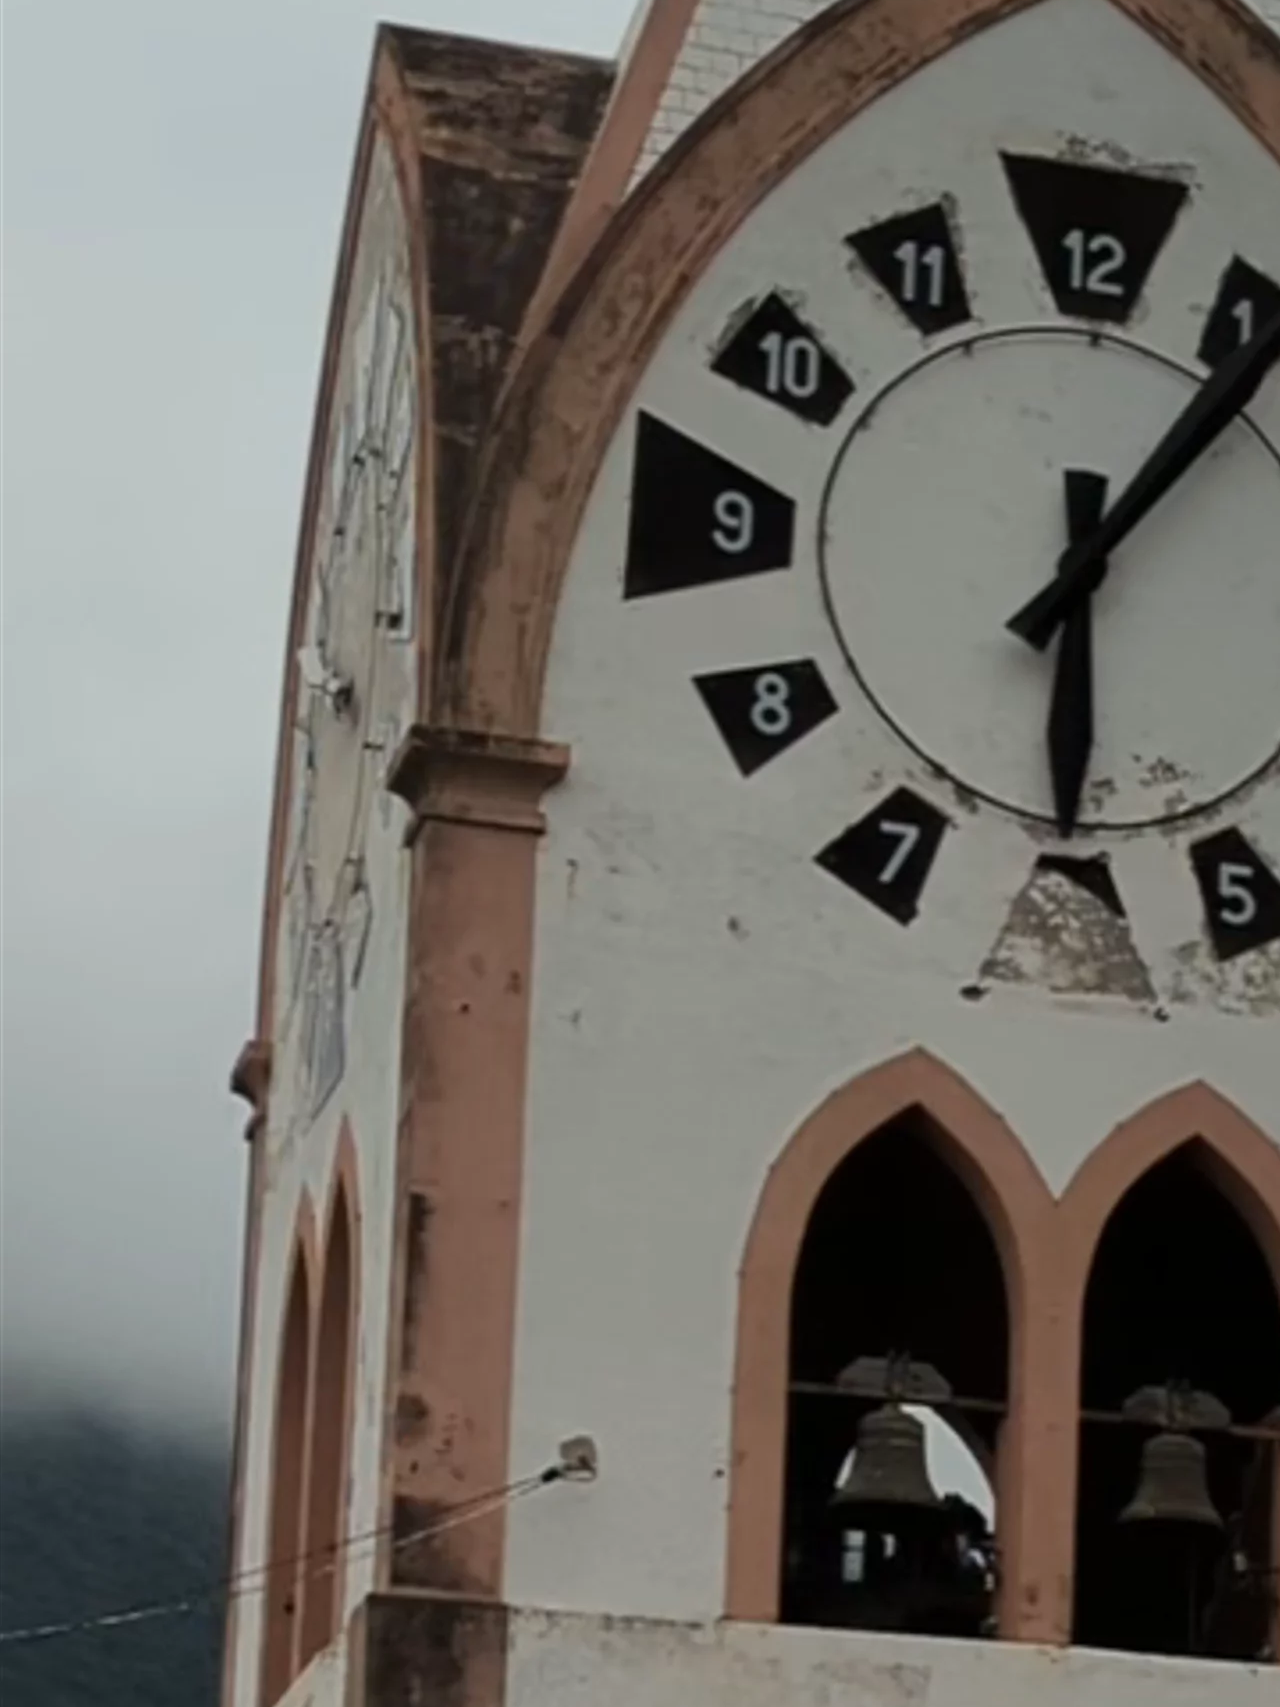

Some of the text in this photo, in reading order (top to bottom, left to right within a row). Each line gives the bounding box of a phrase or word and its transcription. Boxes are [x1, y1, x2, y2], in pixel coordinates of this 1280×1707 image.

[893, 240, 946, 307] 11
[1062, 228, 1126, 296] 12
[1231, 298, 1253, 345] 1
[758, 331, 821, 398] 10
[711, 491, 754, 554] 9
[749, 672, 791, 735] 8
[878, 820, 921, 883] 7
[1217, 861, 1258, 925] 5
